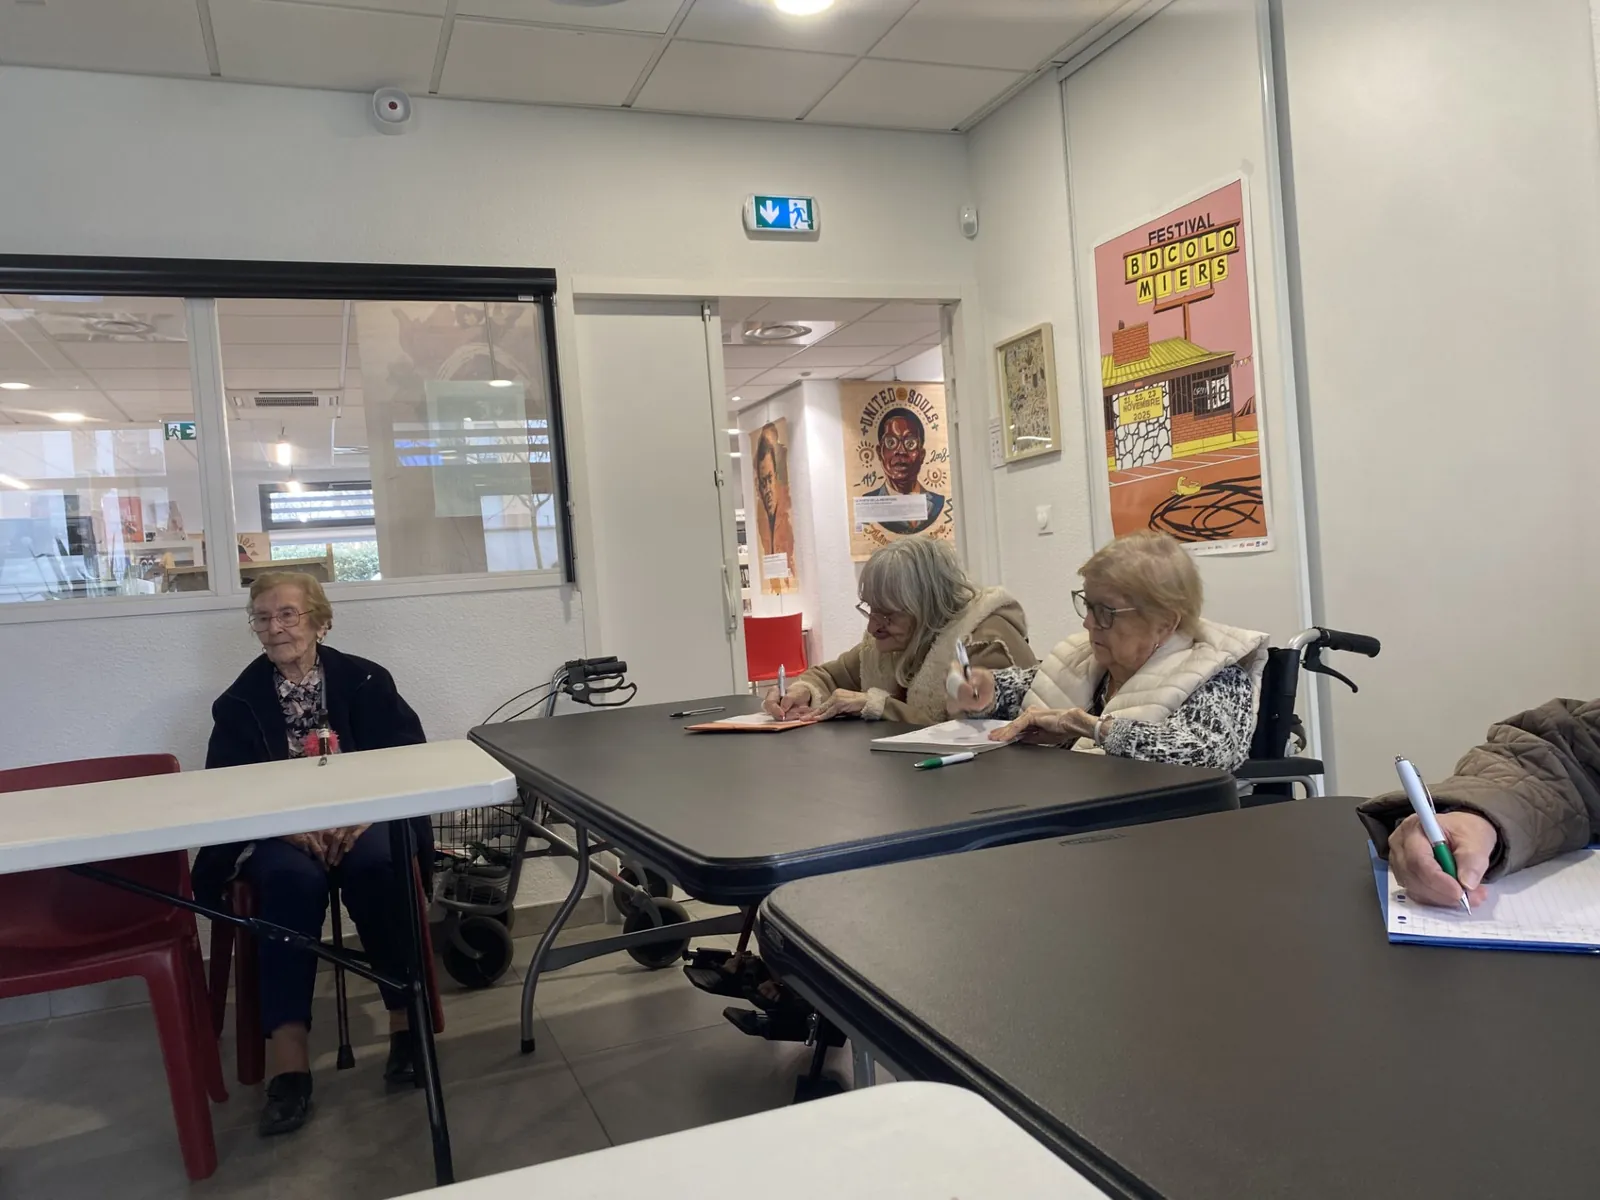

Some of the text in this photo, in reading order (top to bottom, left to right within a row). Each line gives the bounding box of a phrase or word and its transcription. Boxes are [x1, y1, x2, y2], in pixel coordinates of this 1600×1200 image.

[1148, 212, 1215, 245] FESTIVAL
[1139, 258, 1226, 298] MIERS
[860, 387, 939, 427] UNITED SOULS
[1123, 397, 1161, 412] NOVEMBRE
[1133, 411, 1151, 421] 2025
